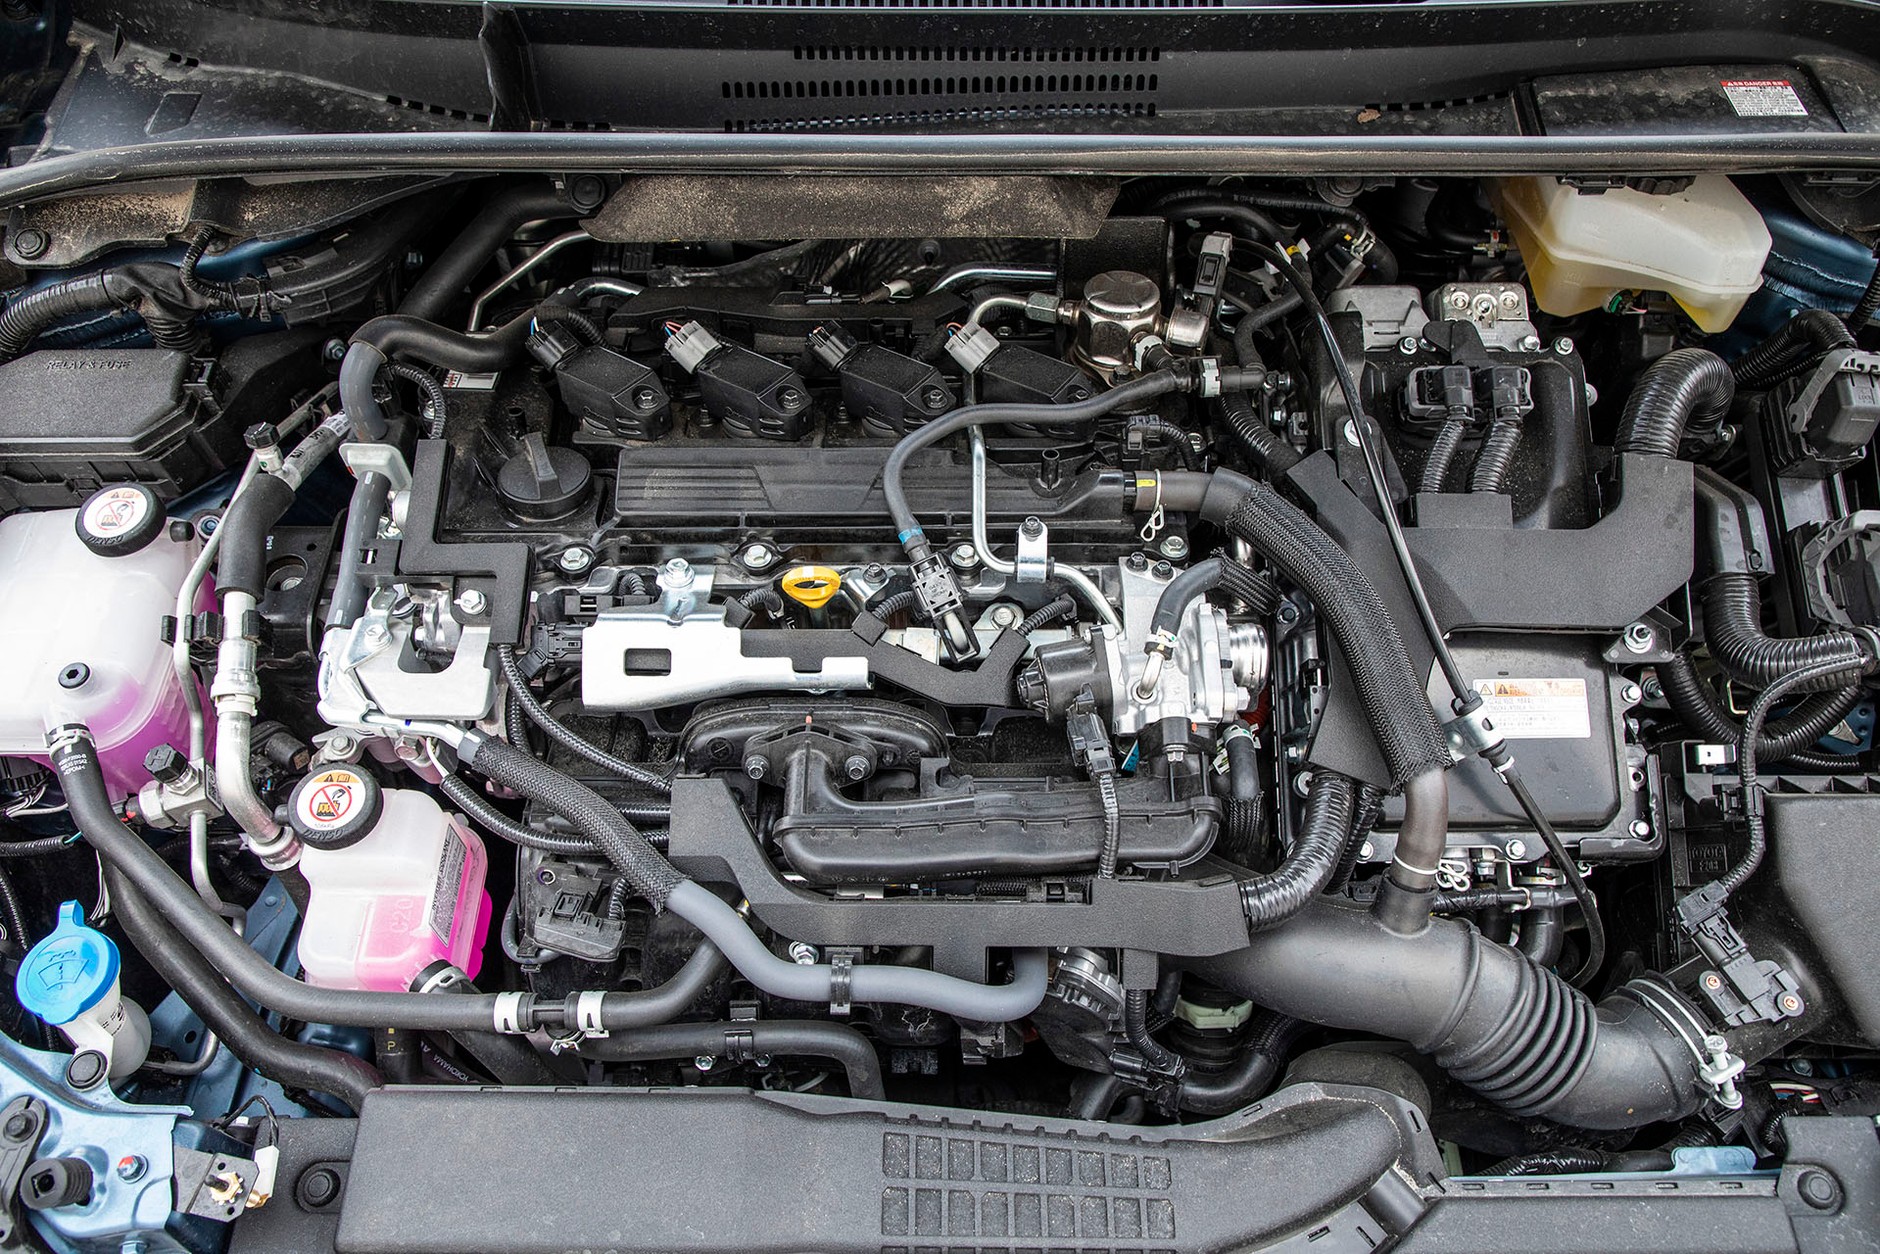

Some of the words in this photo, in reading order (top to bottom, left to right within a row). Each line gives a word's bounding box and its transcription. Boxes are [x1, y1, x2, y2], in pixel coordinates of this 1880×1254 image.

[46, 360, 86, 370] RELAY
[87, 360, 96, 370] &
[99, 360, 132, 370] FUSE
[87, 535, 124, 545] DENSO
[302, 828, 345, 841] DENSO
[438, 838, 451, 875] COOLANT
[387, 1040, 396, 1051] P
[432, 1053, 470, 1083] YOKOHAMA
